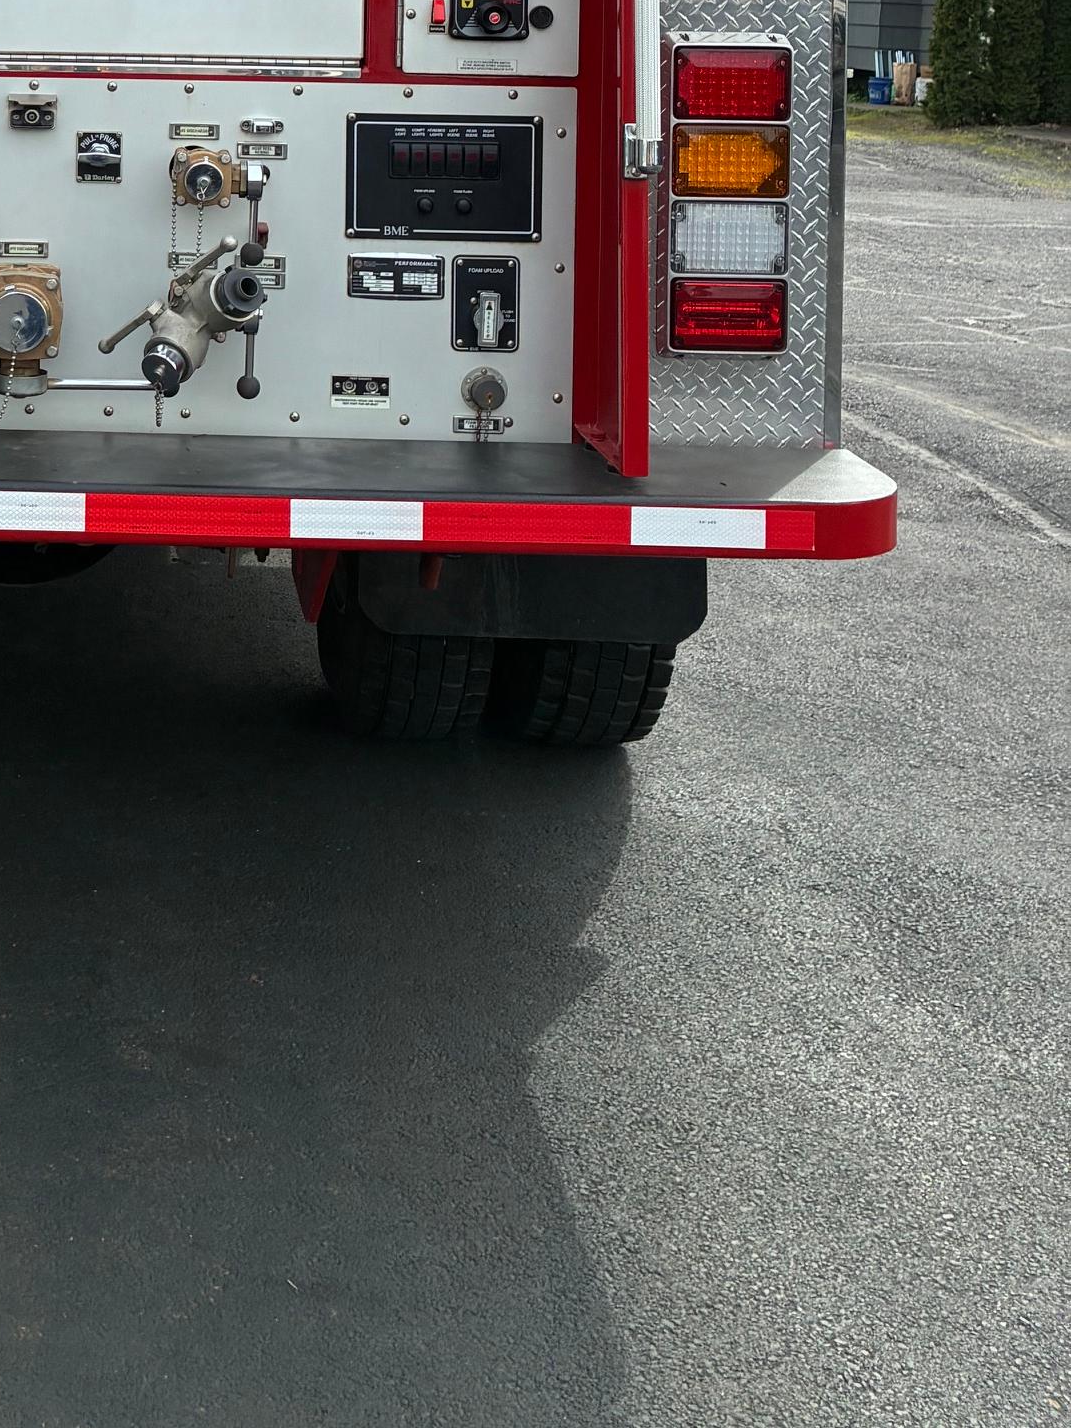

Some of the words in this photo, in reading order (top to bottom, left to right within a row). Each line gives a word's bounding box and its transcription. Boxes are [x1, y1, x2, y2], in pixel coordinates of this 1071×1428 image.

[79, 134, 97, 149] PULL
[99, 133, 120, 150] PRIME
[92, 174, 115, 182] Darley
[384, 226, 409, 236] BME
